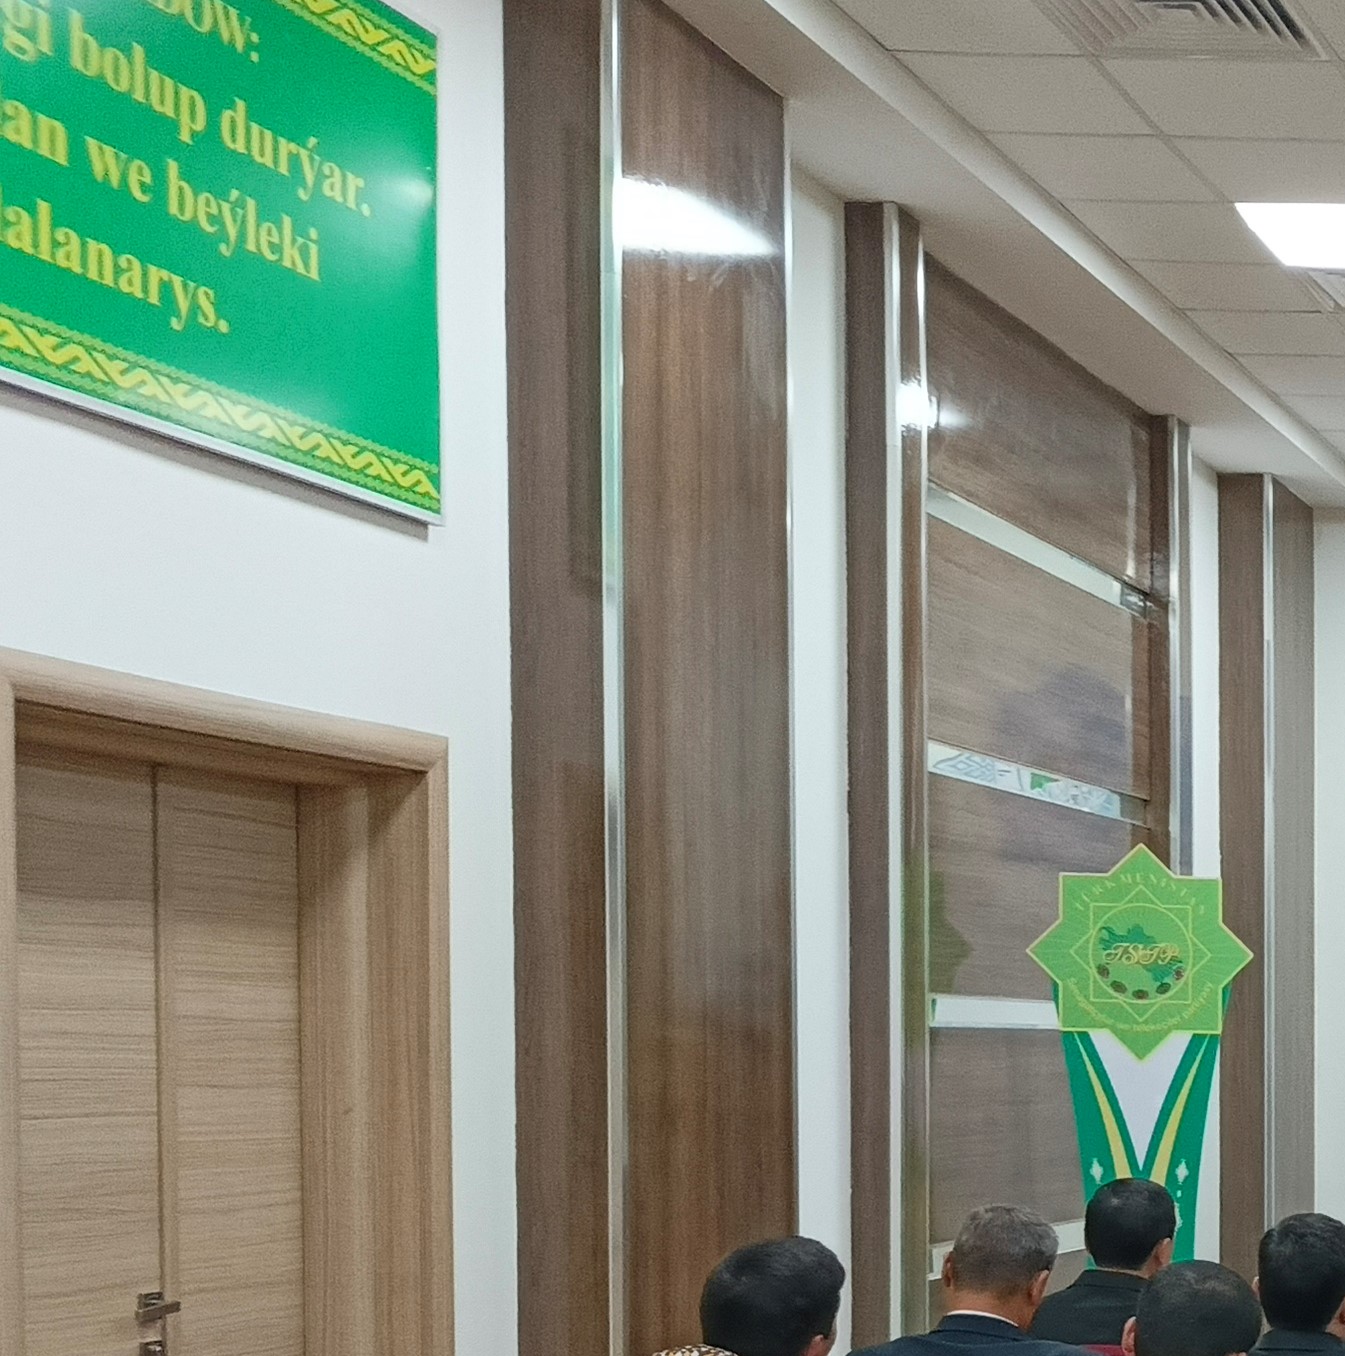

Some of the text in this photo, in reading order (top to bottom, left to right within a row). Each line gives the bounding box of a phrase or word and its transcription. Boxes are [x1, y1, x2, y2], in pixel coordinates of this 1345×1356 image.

[69, 7, 207, 144] bolup
[220, 98, 372, 217] durýar.
[84, 136, 153, 202] we
[167, 159, 321, 281] beýleki
